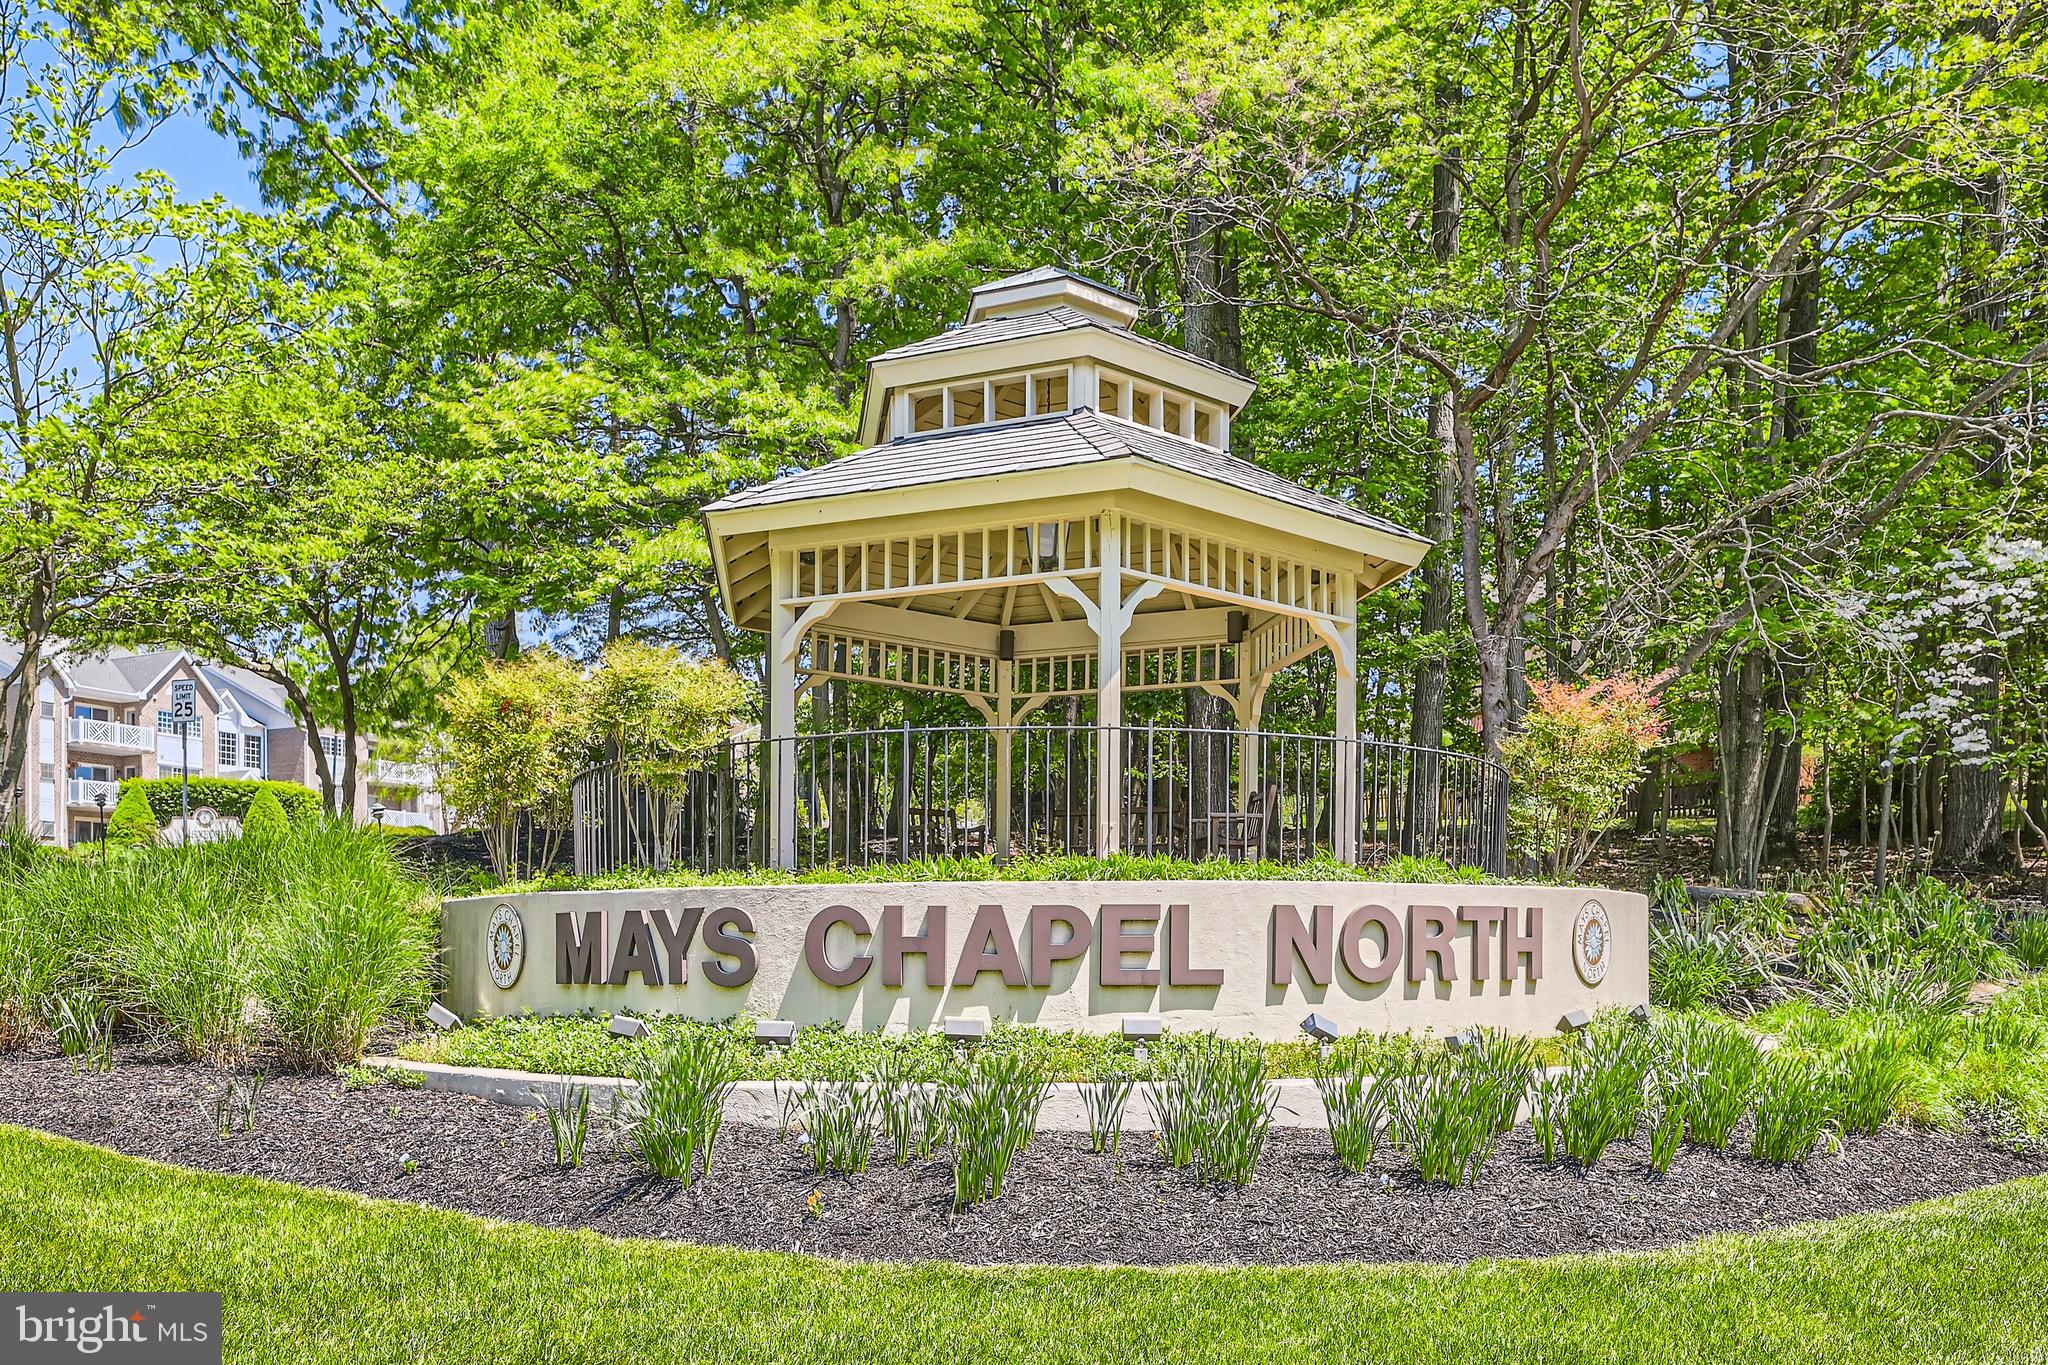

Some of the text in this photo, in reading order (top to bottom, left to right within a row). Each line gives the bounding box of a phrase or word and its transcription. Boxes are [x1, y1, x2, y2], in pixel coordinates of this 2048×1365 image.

[174, 684, 194, 692] SPEED
[175, 693, 192, 701] LIMIT
[174, 702, 193, 717] 25
[555, 904, 1543, 988] MAYS CHAPEL NORTH
